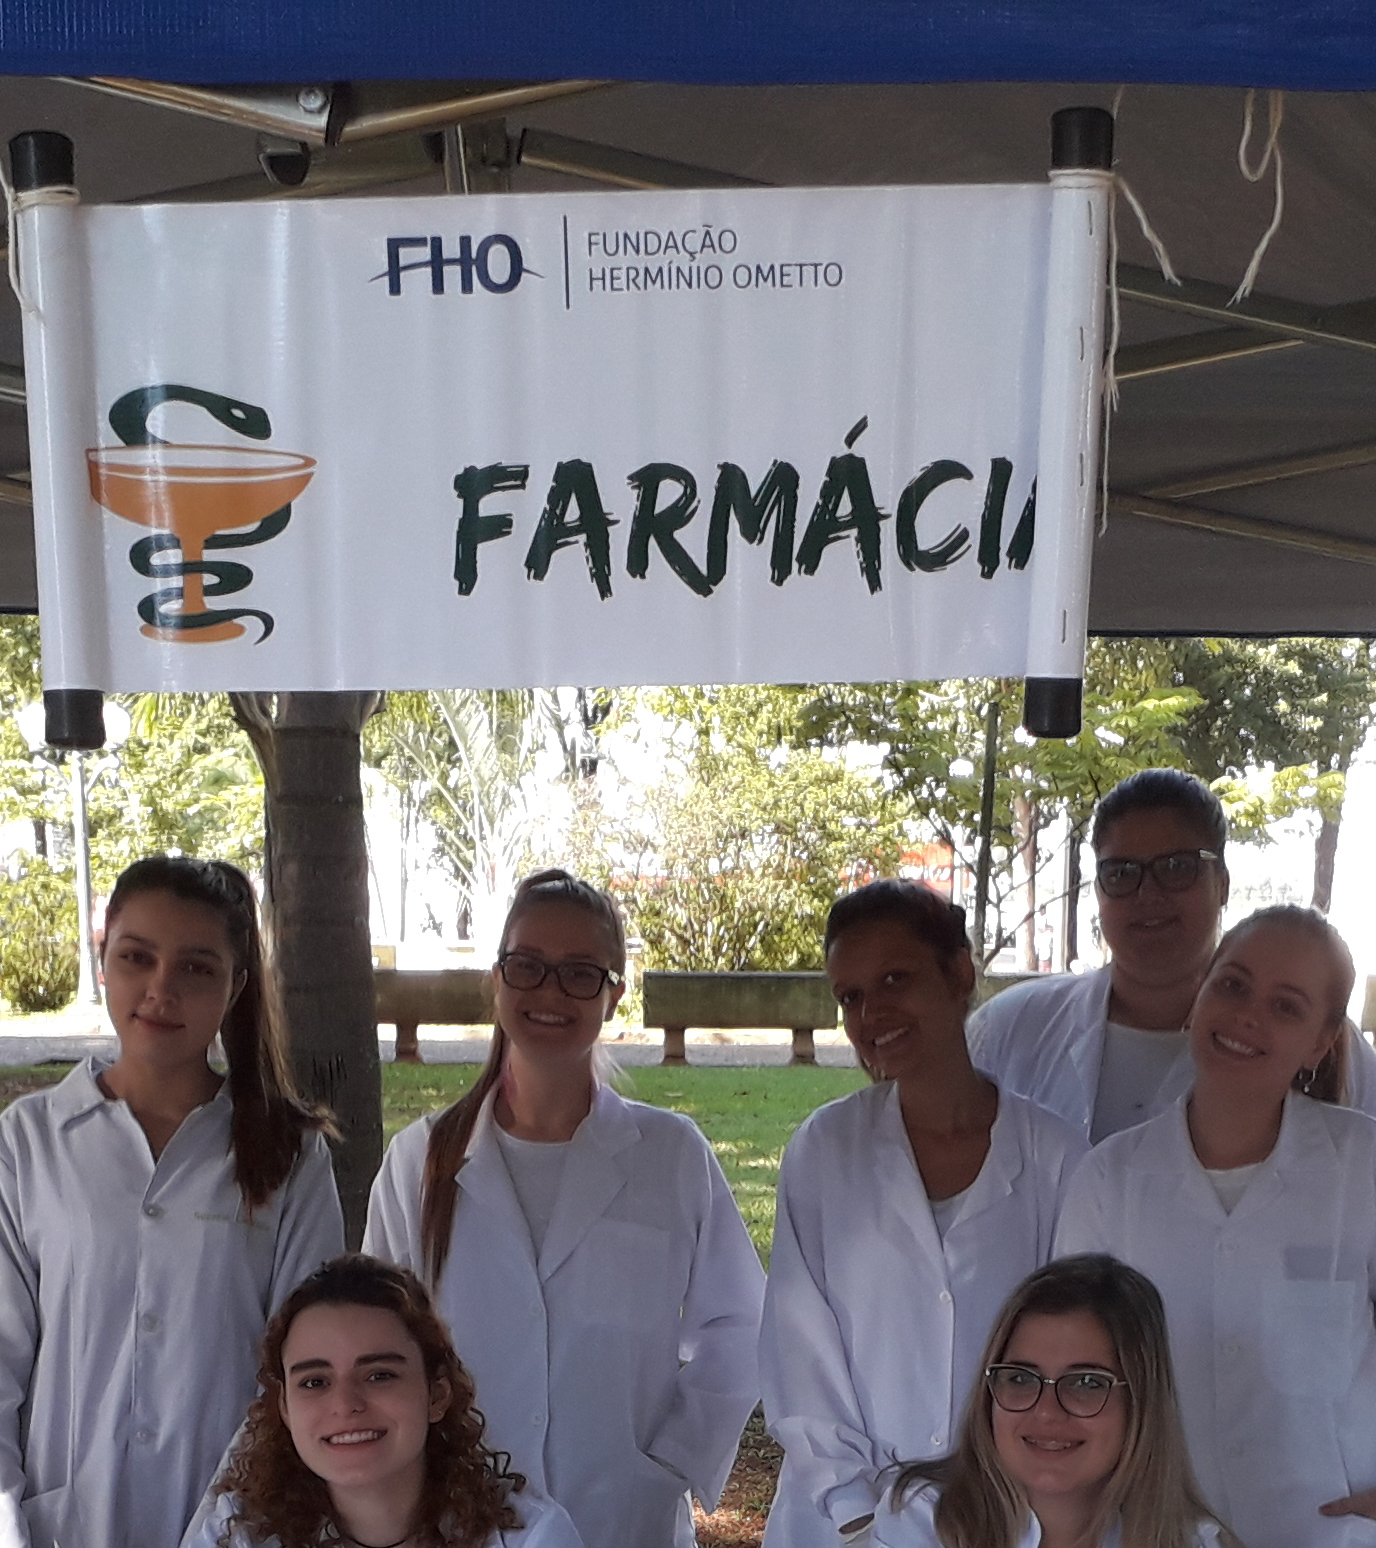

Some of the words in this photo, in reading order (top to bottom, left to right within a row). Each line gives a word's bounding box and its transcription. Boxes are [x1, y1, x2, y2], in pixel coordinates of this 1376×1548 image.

[588, 225, 738, 261] FUNDAÇÃO
[384, 233, 525, 296] FHO
[588, 260, 723, 293] HERMÍNIO
[733, 262, 844, 290] OMETTO
